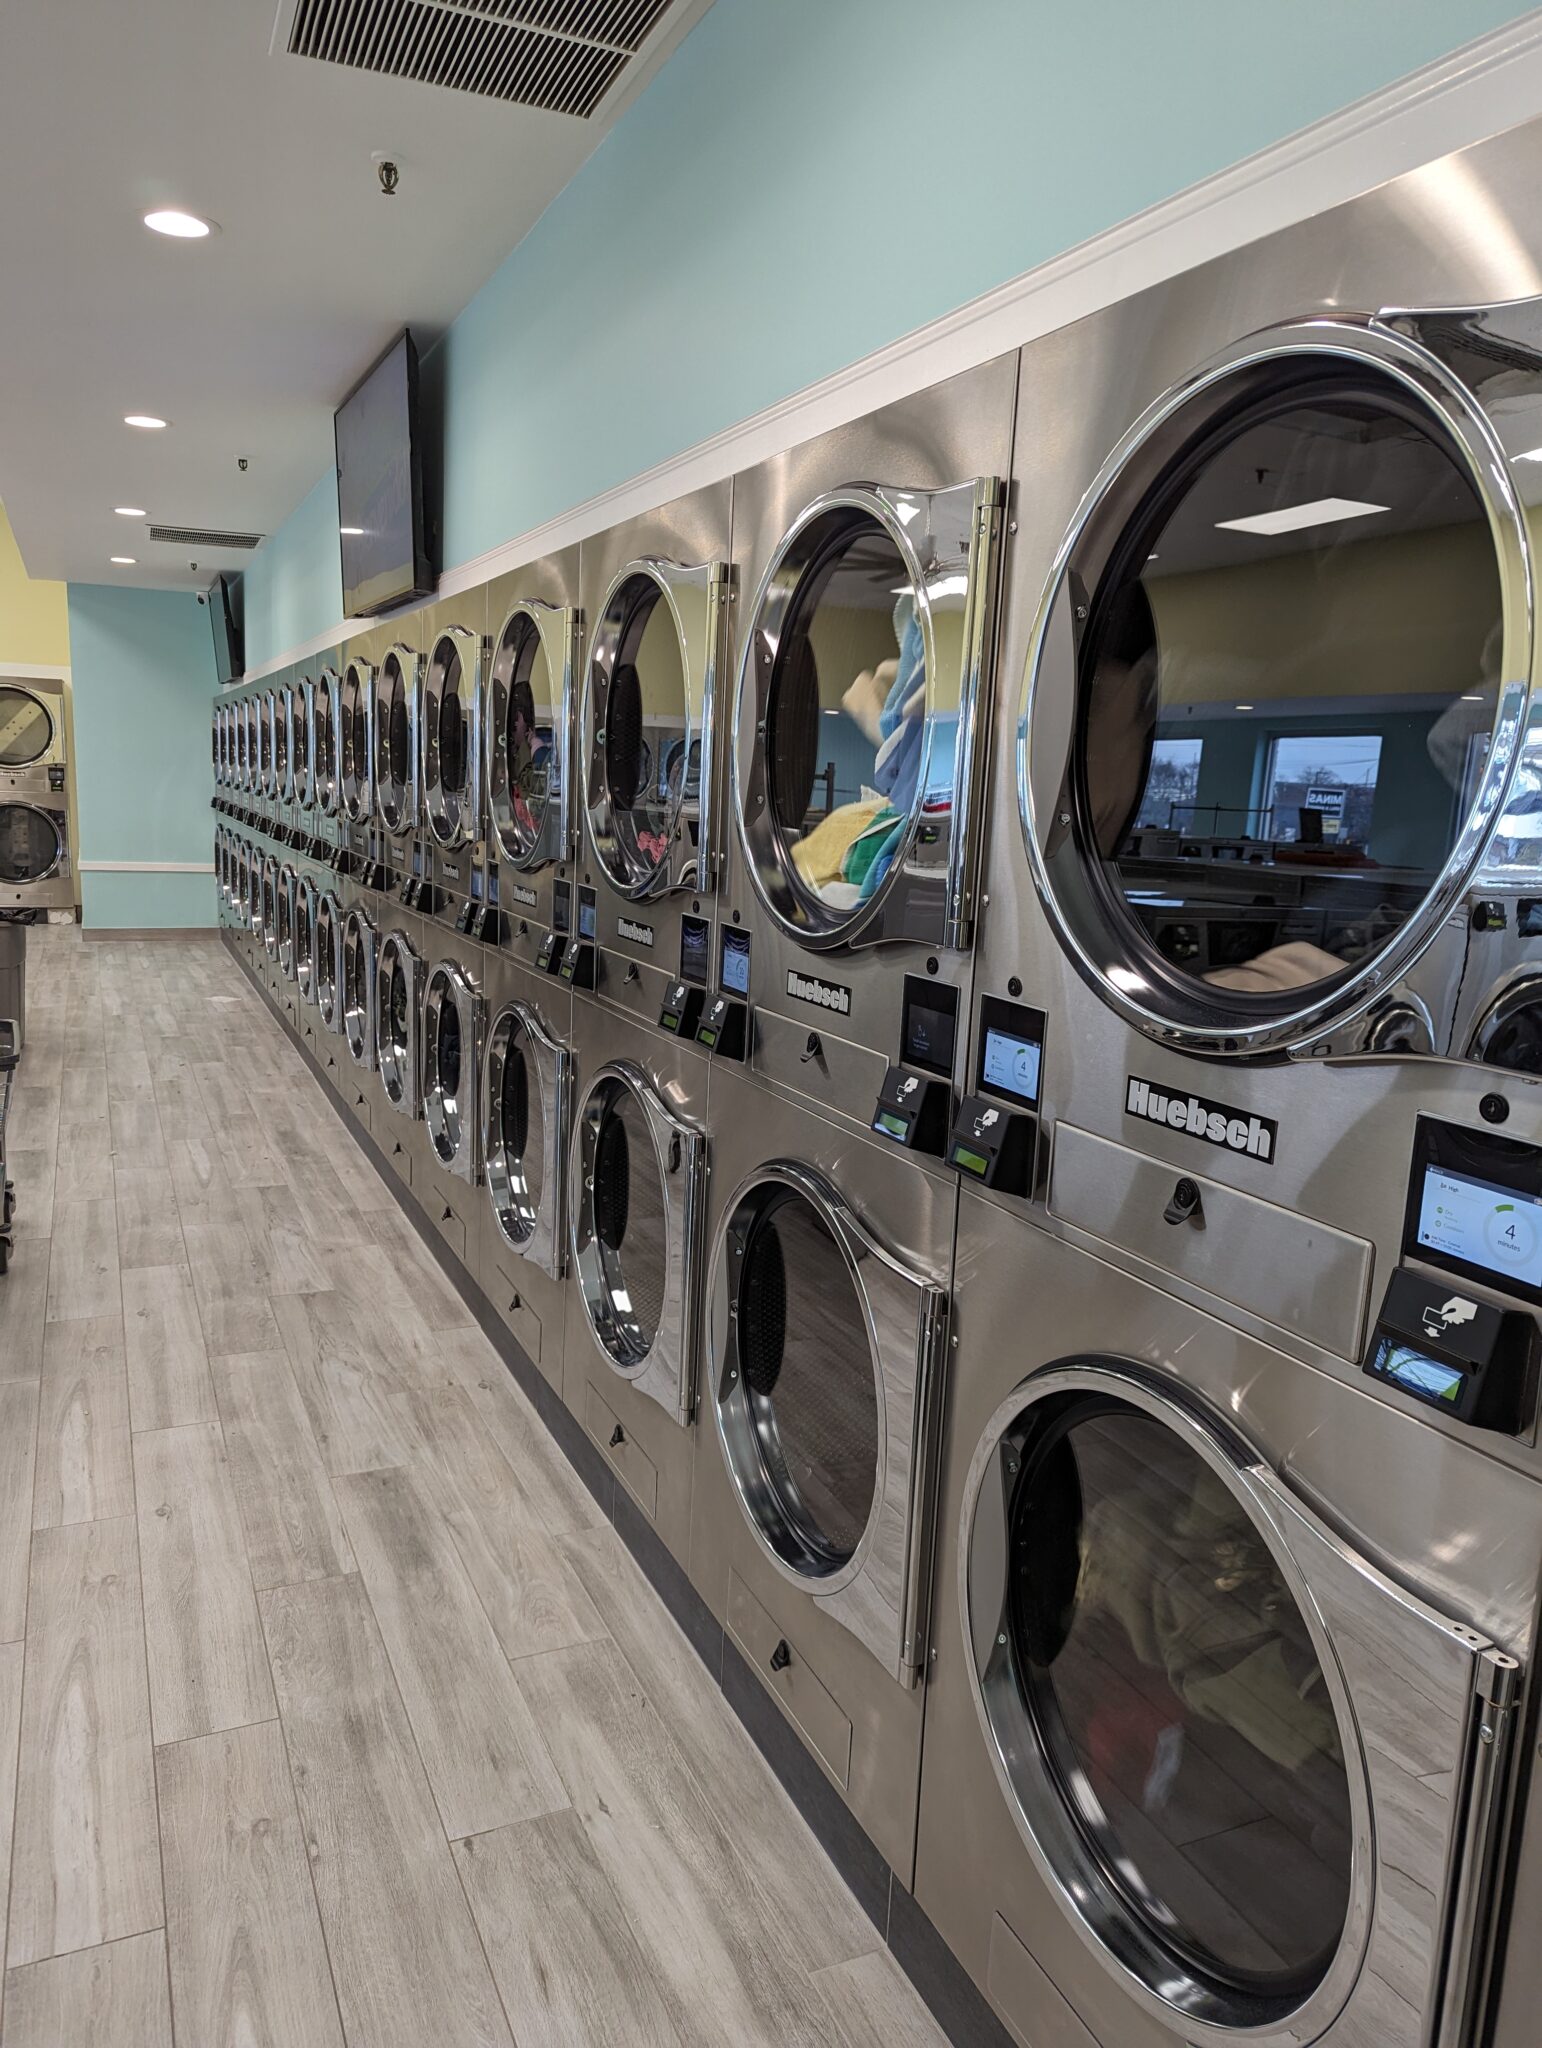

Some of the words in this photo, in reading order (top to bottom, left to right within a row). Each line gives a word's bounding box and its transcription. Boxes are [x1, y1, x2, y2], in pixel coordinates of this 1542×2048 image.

[787, 972, 849, 1013] Huebsch
[1020, 1061, 1026, 1071] 4
[1127, 1079, 1272, 1160] Huebsch
[1448, 1185, 1459, 1193] High
[1505, 1224, 1516, 1240] 4
[1497, 1239, 1521, 1253] minutes
